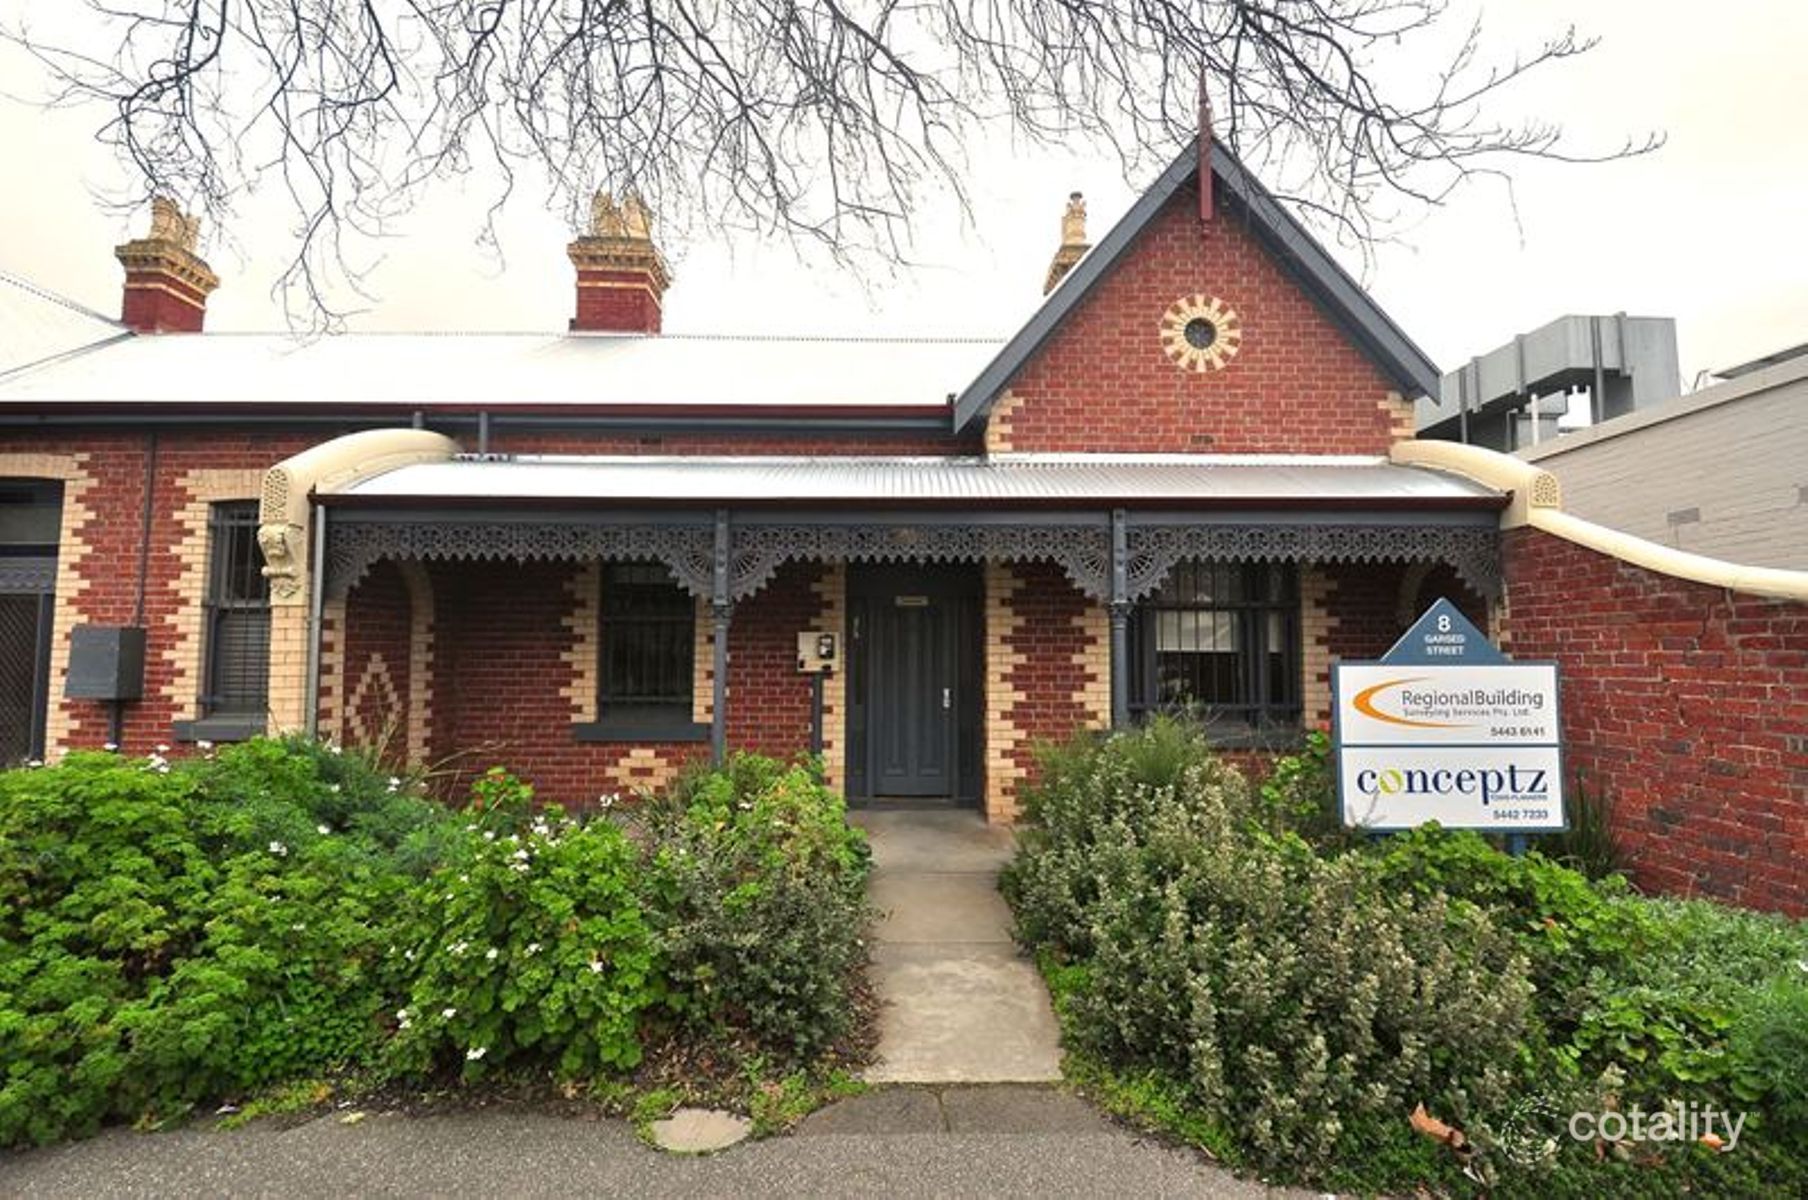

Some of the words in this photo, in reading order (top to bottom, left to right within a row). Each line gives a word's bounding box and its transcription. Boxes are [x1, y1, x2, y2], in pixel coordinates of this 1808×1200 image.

[1437, 614, 1451, 632] 8
[1426, 645, 1464, 655] STREET
[1402, 690, 1543, 710] RegionalBuilding
[1491, 727, 1516, 737] 5443
[1520, 727, 1545, 737] 6141
[1357, 764, 1547, 805] conceptz
[1493, 809, 1519, 819] 5442
